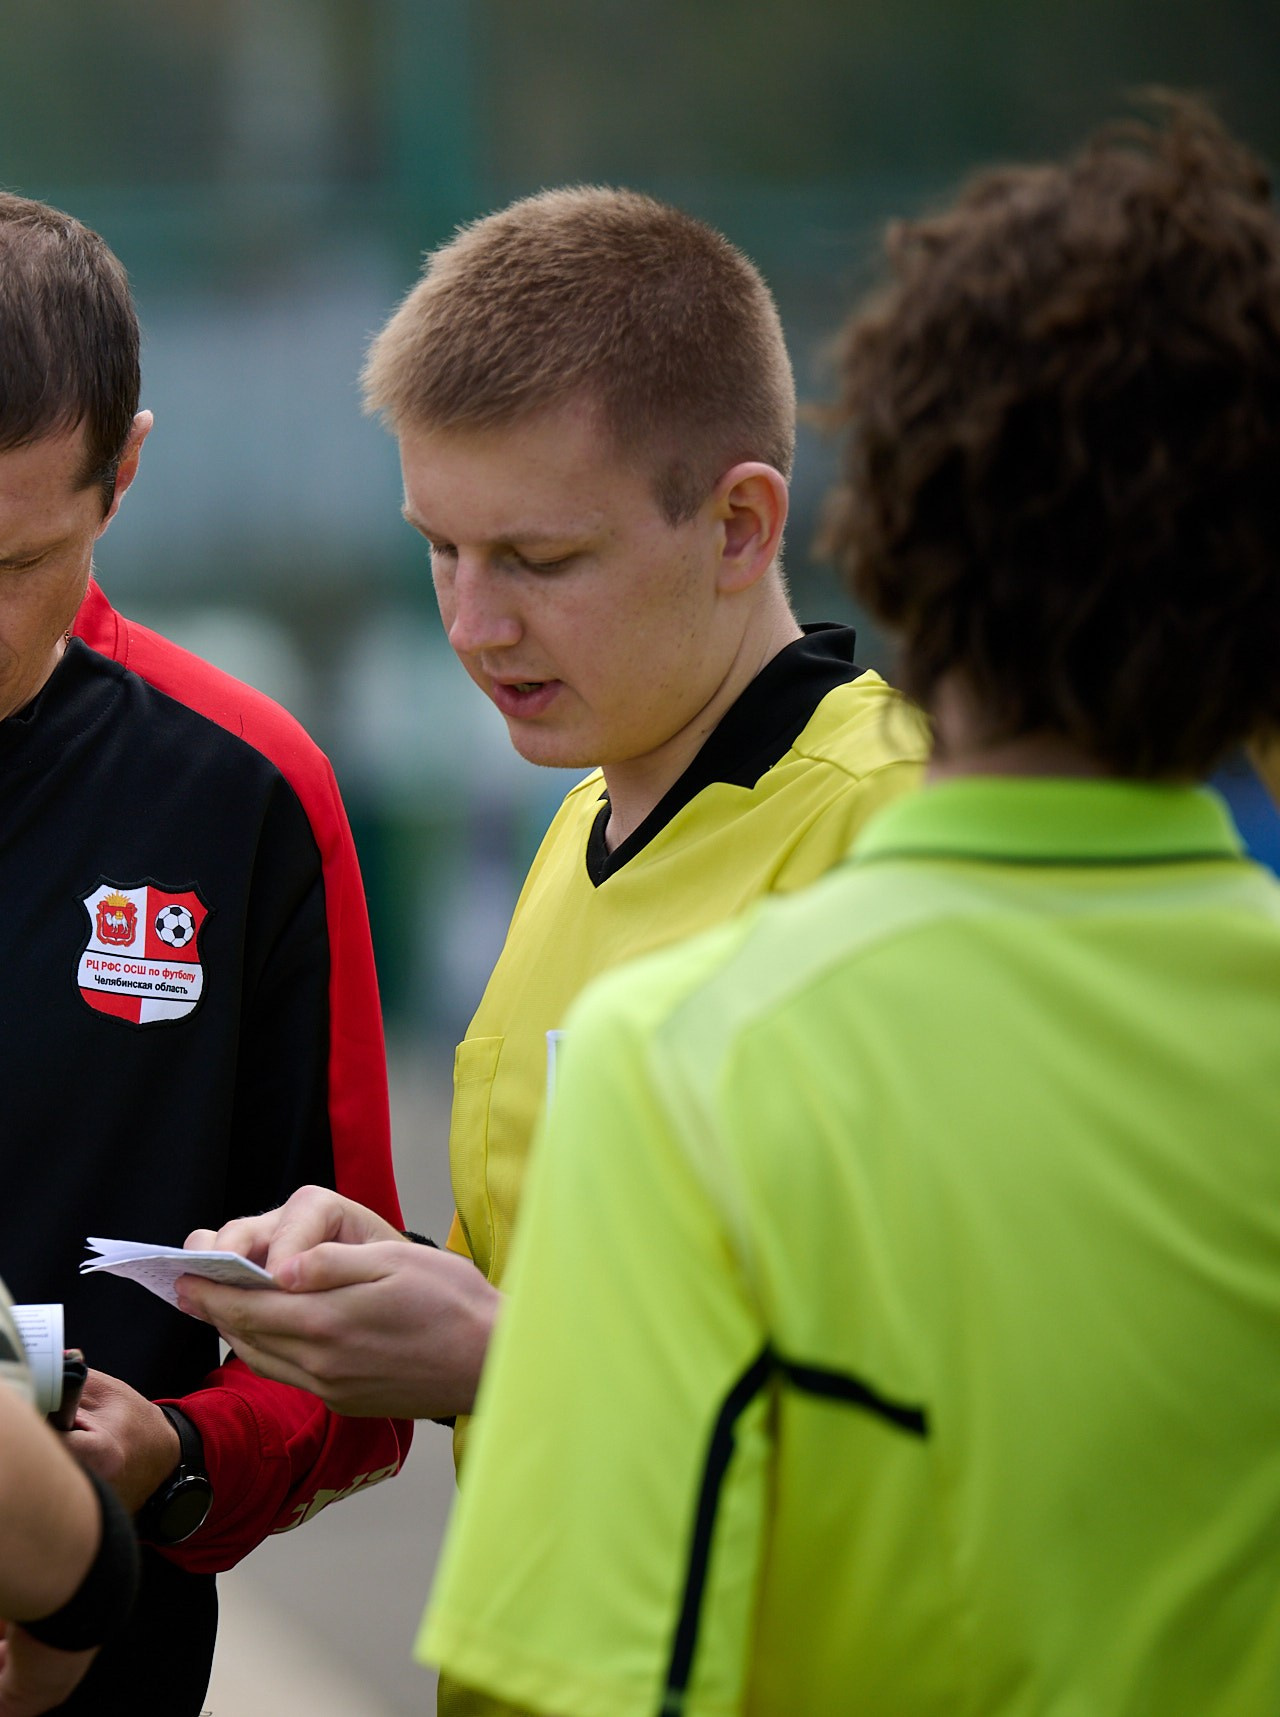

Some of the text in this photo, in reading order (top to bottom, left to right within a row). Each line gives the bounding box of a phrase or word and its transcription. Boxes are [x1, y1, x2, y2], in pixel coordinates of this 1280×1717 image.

[86, 959, 196, 983] РЦ РФС ОСШ по футболу
[94, 974, 188, 995] Челябинская область
